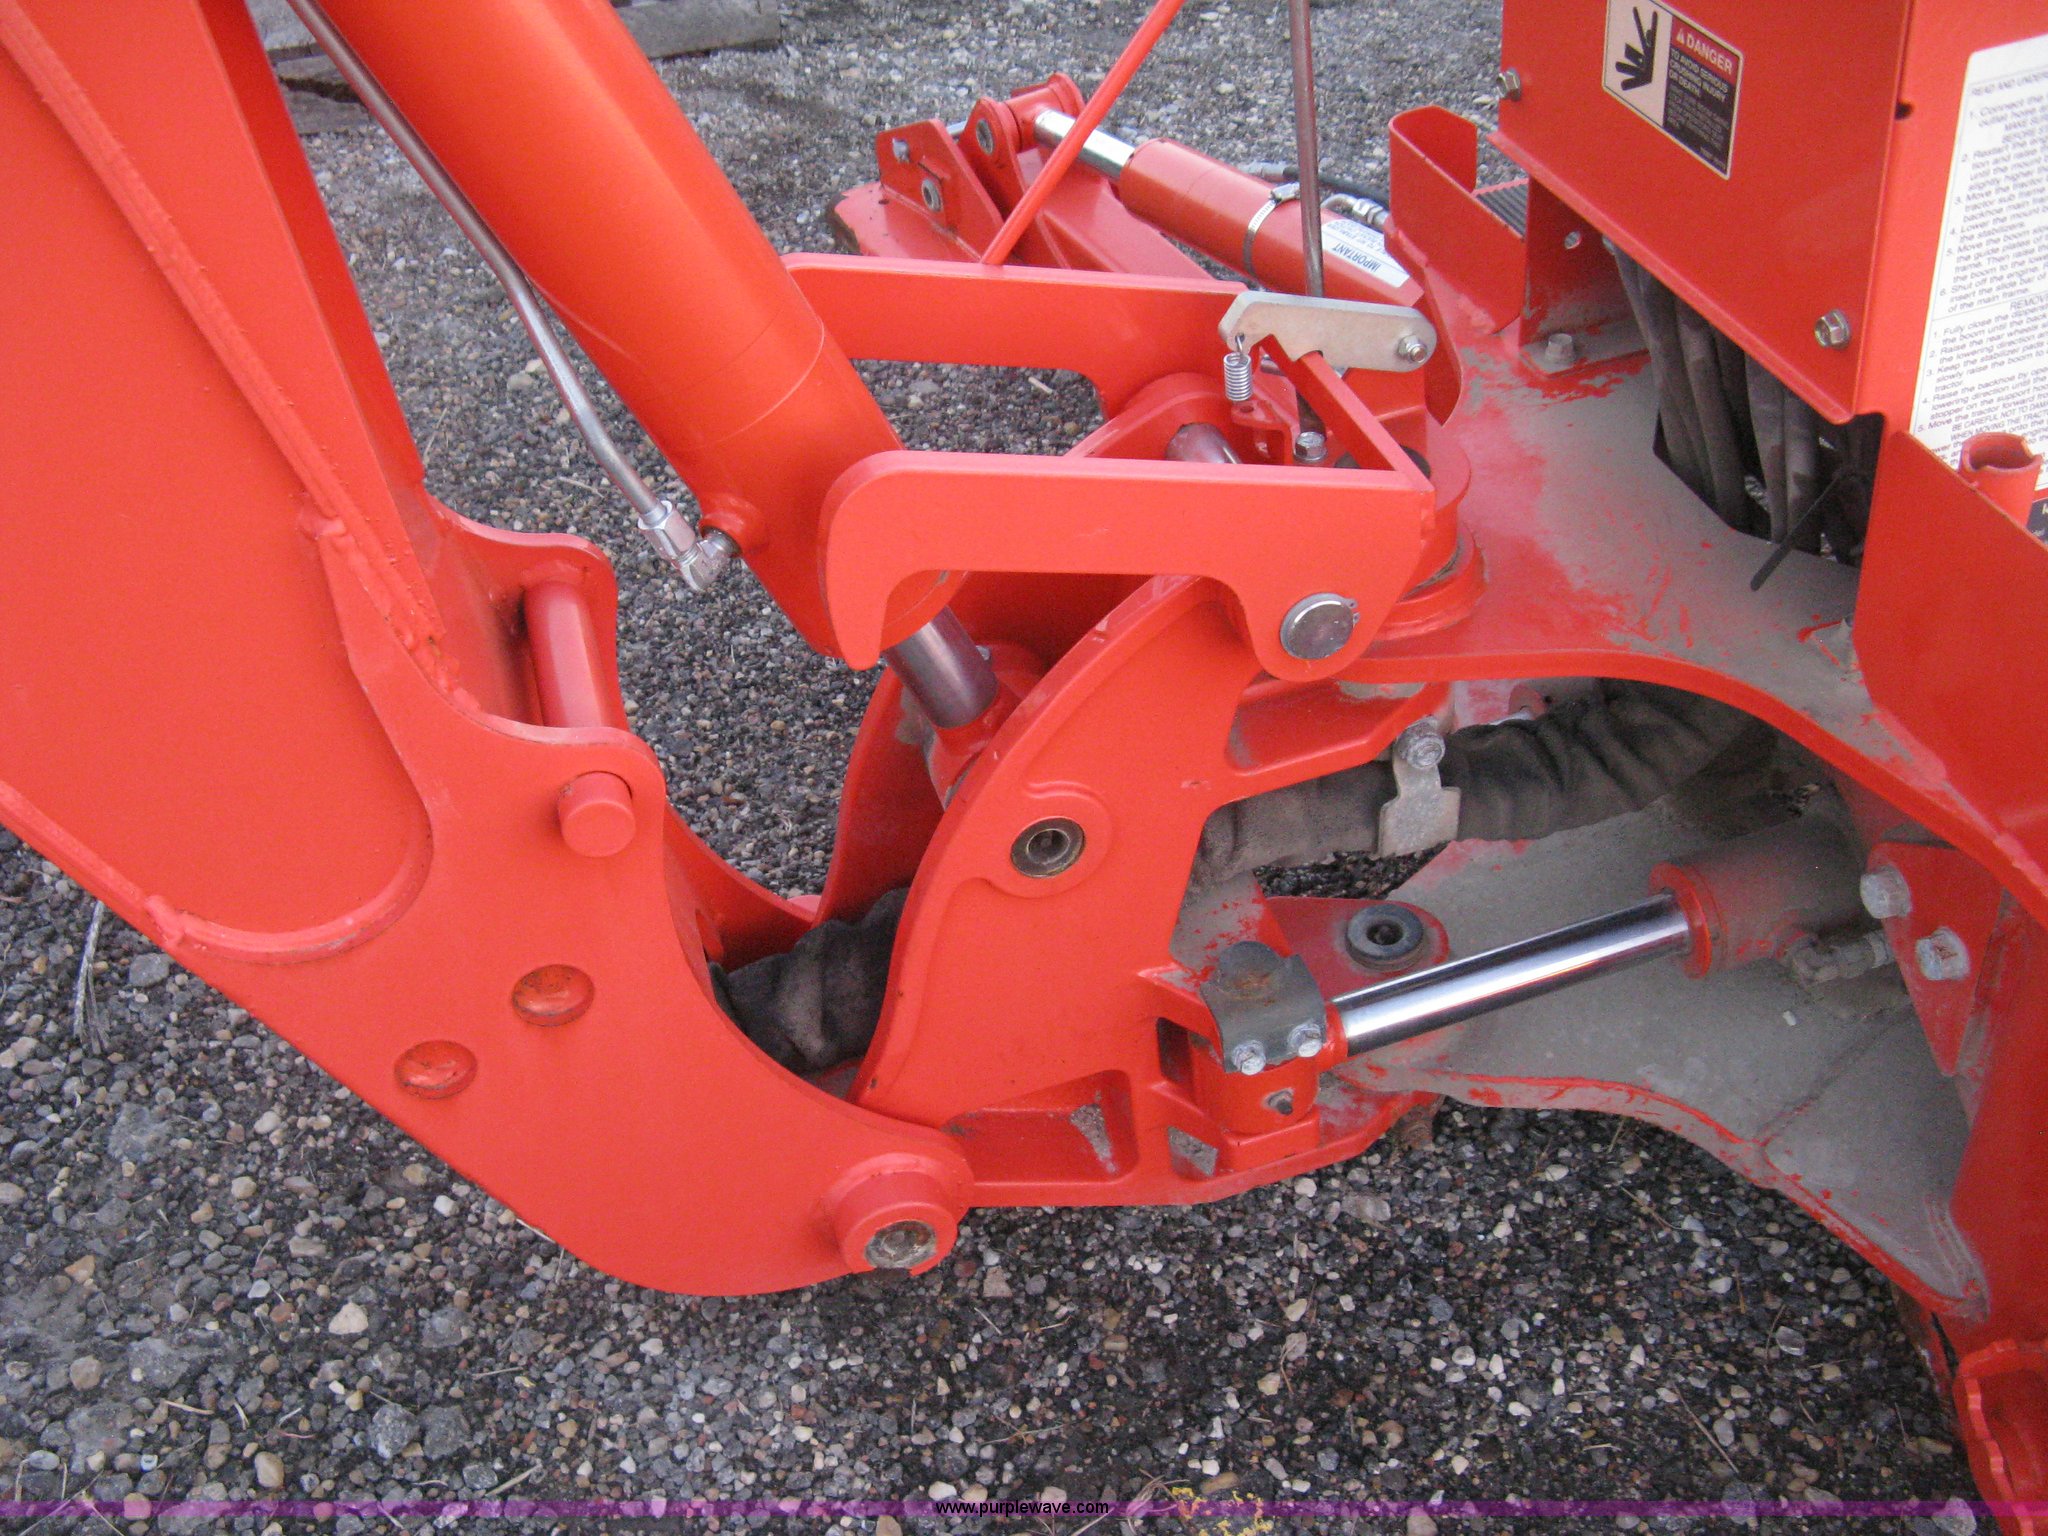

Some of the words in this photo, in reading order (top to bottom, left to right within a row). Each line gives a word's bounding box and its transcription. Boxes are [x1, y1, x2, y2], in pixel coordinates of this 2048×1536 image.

[1686, 32, 1732, 75] DANGER
[1957, 242, 1983, 253] Move
[1332, 243, 1381, 273] IMPORTANT
[1951, 281, 1972, 293] Shut
[1979, 287, 1993, 296] the
[1960, 301, 1974, 310] the
[1942, 337, 1957, 346] the
[1960, 329, 1985, 341] boom
[2009, 319, 2024, 328] the
[1944, 325, 1964, 337] Fully
[1968, 318, 1992, 330] close
[1994, 314, 2009, 323] the
[1941, 343, 1966, 354] Raise
[1969, 339, 1983, 348] the
[1937, 363, 1960, 374] Keep
[1963, 358, 1978, 368] the
[1940, 355, 1954, 364] the
[1991, 360, 2005, 369] the
[2007, 353, 2033, 365] boom
[1933, 390, 1959, 401] Raise
[1961, 386, 1975, 395] the
[1978, 376, 2015, 390] backhoe
[1980, 398, 1994, 407] the
[2001, 408, 2016, 419] NOT
[1928, 418, 1952, 429] Move
[1955, 414, 1969, 423] the
